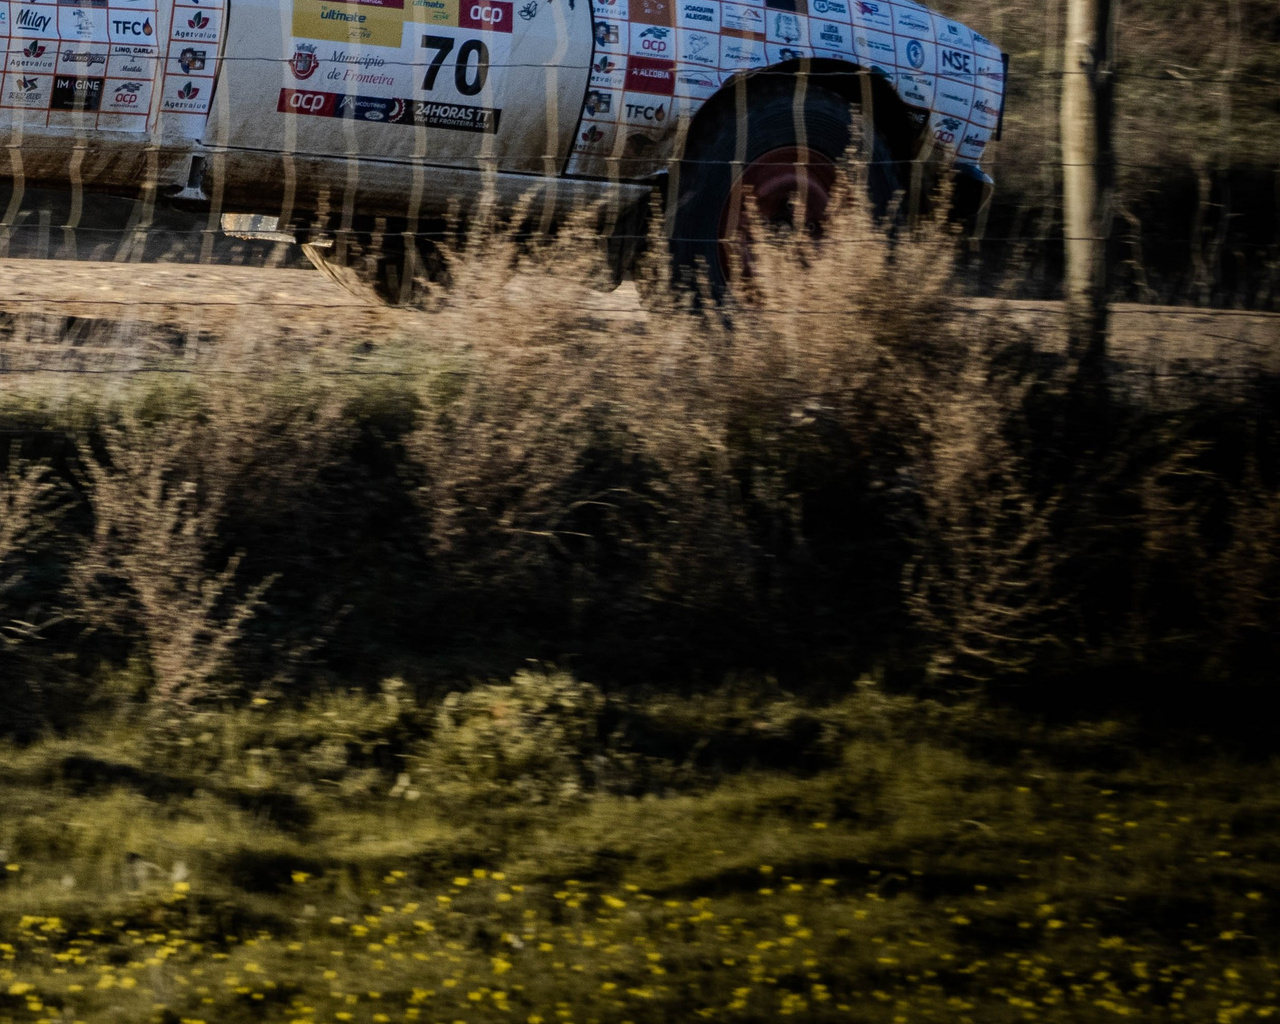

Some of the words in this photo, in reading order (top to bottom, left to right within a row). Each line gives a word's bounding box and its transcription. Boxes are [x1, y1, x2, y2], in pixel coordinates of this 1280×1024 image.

[320, 8, 366, 23] ultimate
[470, 5, 503, 25] acp
[684, 4, 714, 14] JOAQUIM
[15, 9, 51, 31] Milay
[685, 13, 713, 22] ALEGRIA
[113, 20, 142, 36] TFC
[115, 46, 132, 54] LINO,
[642, 39, 666, 53] acp
[330, 50, 385, 68] Município
[420, 34, 490, 97] 70
[941, 49, 971, 74] NSE
[121, 65, 142, 73] Matilde
[640, 69, 670, 79] ALCOBIA
[327, 68, 341, 80] de
[342, 69, 395, 87] Fronteira
[115, 93, 137, 104] acp
[289, 92, 325, 112] acp
[416, 103, 473, 120] 24HORAS
[475, 109, 492, 122] TT
[626, 104, 655, 120] TFC
[439, 118, 474, 127] FRONTEIRA
